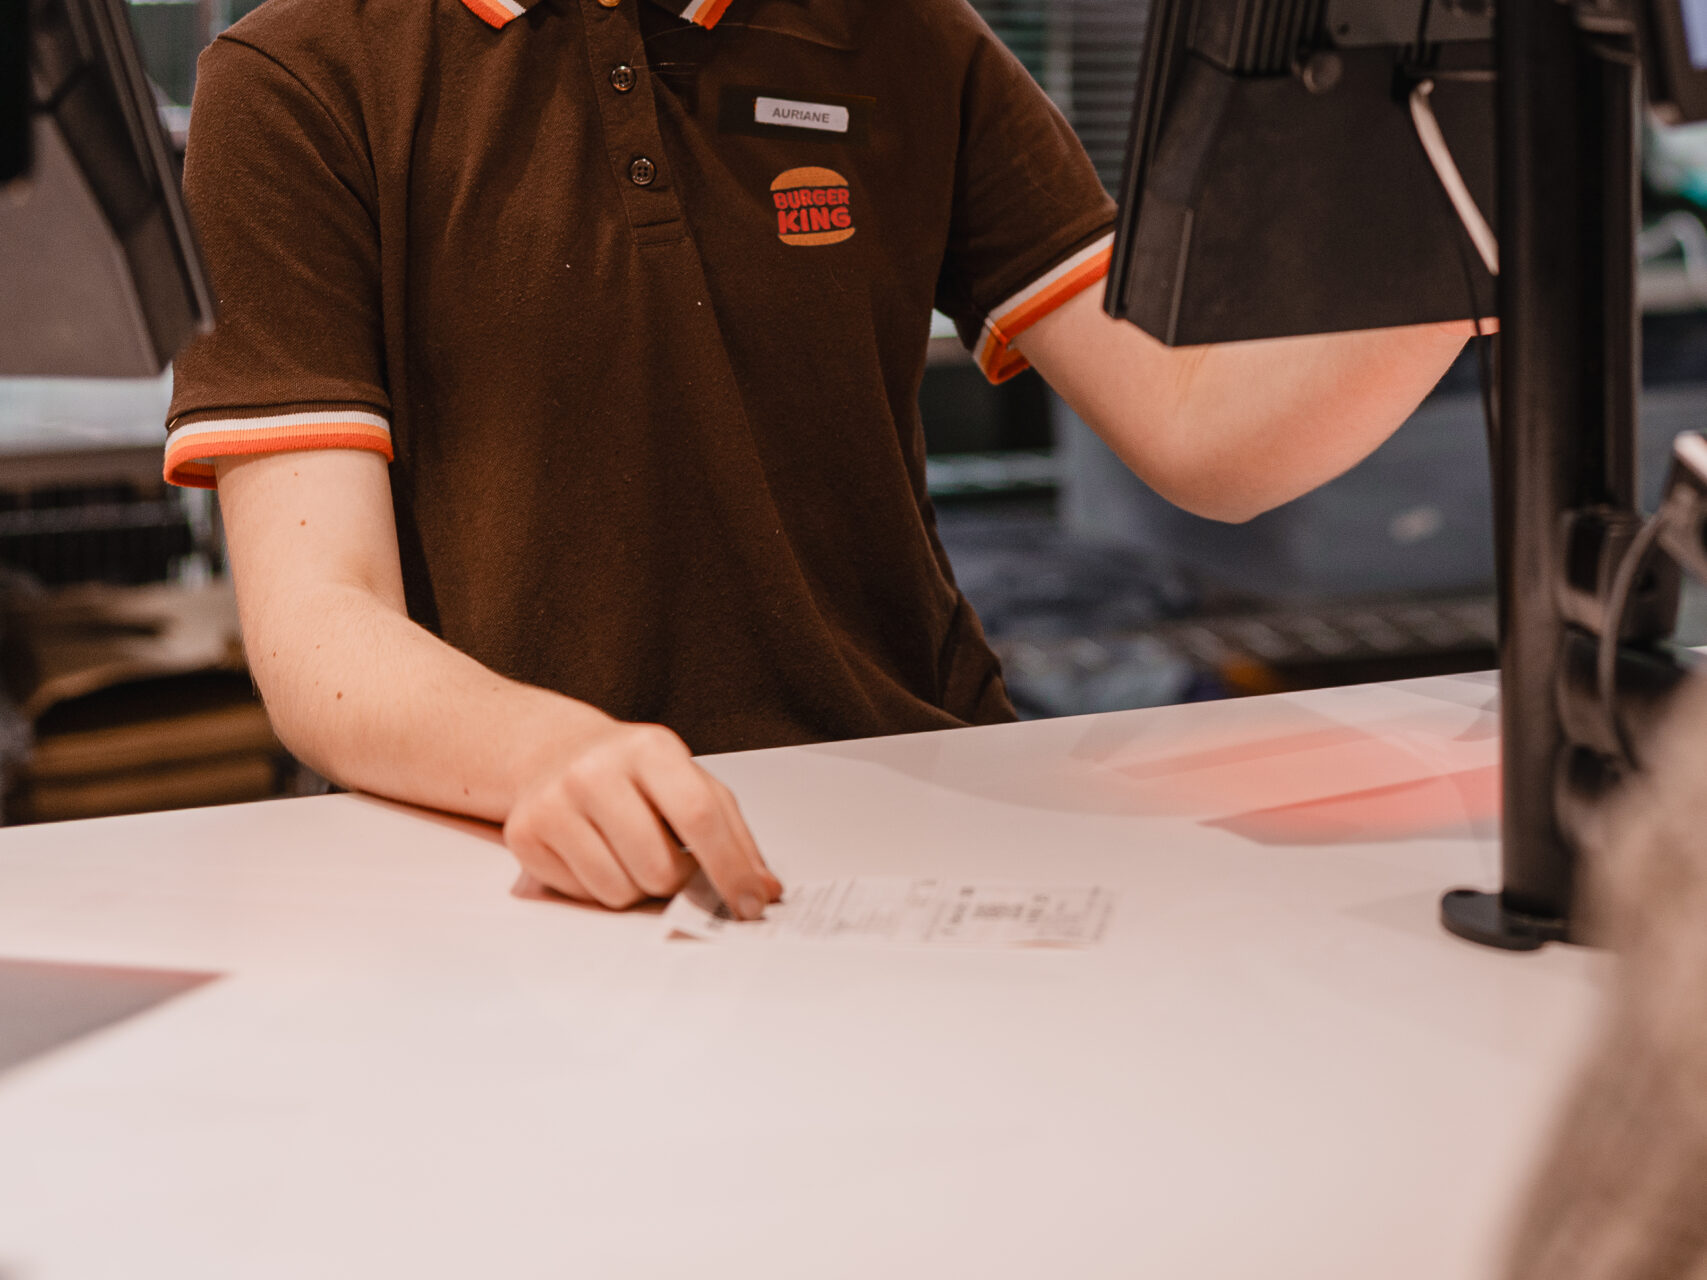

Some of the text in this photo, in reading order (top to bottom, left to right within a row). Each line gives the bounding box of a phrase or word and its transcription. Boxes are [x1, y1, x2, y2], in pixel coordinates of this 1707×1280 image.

[772, 107, 830, 123] AURIANE
[773, 188, 849, 209] BURGER
[777, 207, 851, 234] KING
